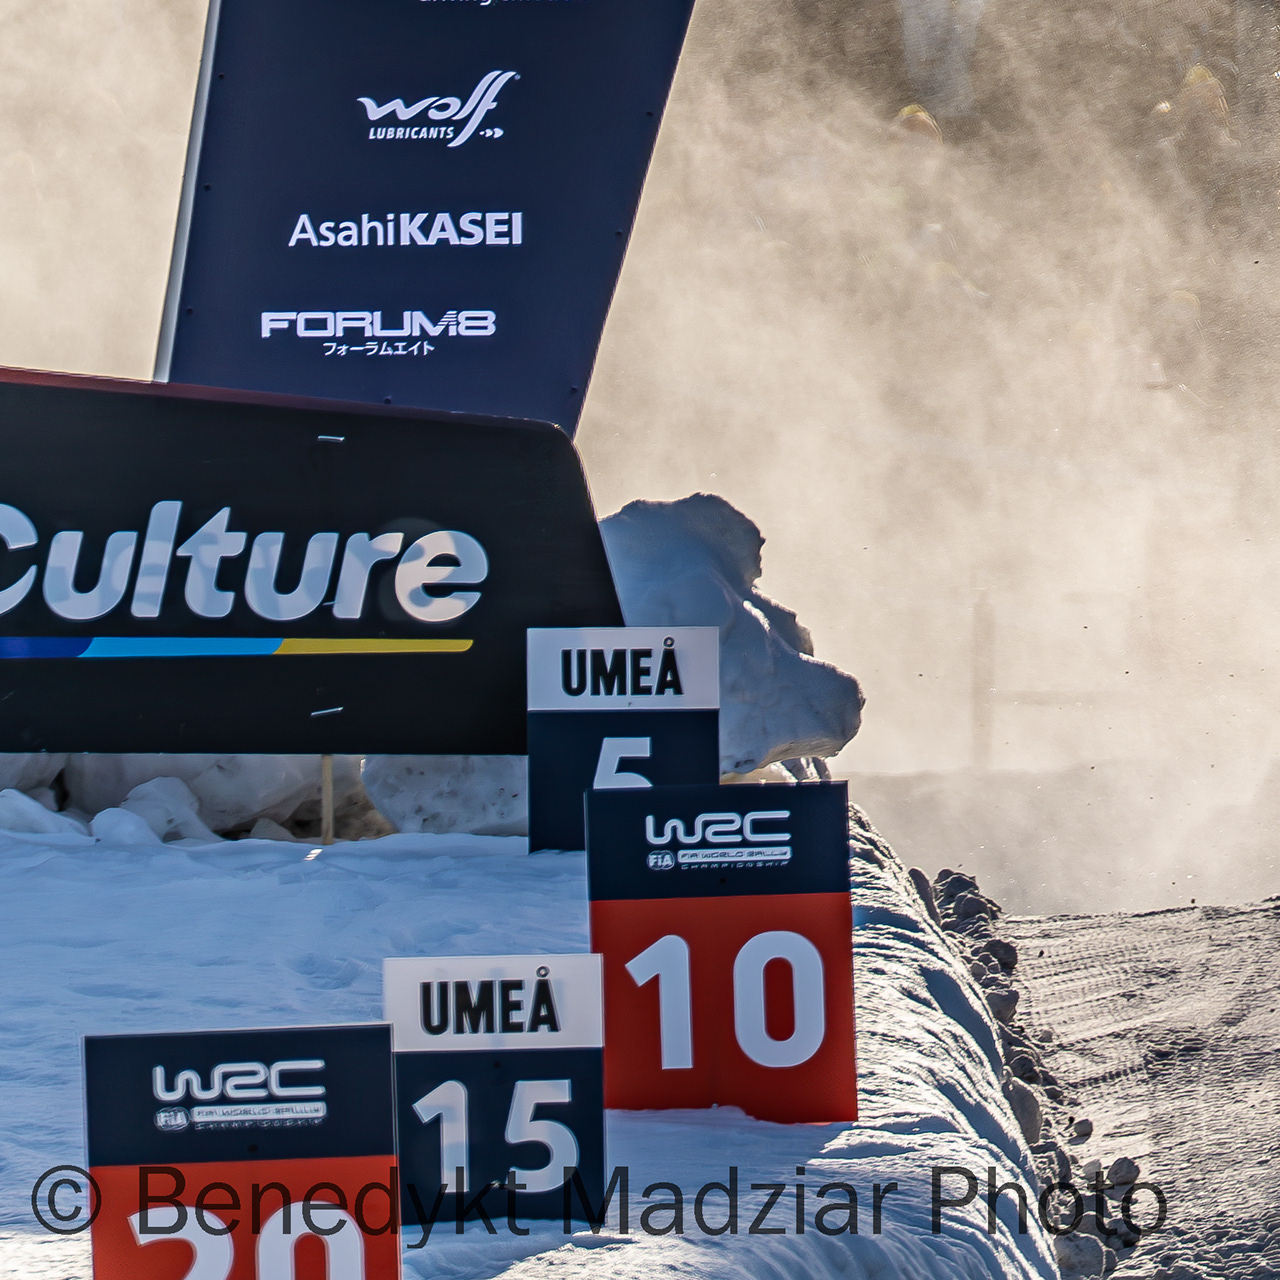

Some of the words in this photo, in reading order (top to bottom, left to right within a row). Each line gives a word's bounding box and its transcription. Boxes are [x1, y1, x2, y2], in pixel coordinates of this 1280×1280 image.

[368, 126, 455, 140] LUBRICANTS
[260, 310, 497, 339] FORUM8
[322, 341, 435, 356] フォーラムエイト
[561, 636, 683, 697] UMEÅ
[645, 810, 792, 845] WRC
[421, 966, 559, 1036] UMEÅ
[624, 930, 825, 1070] 10
[152, 1059, 327, 1102] WRC
[412, 1080, 580, 1194] 15
